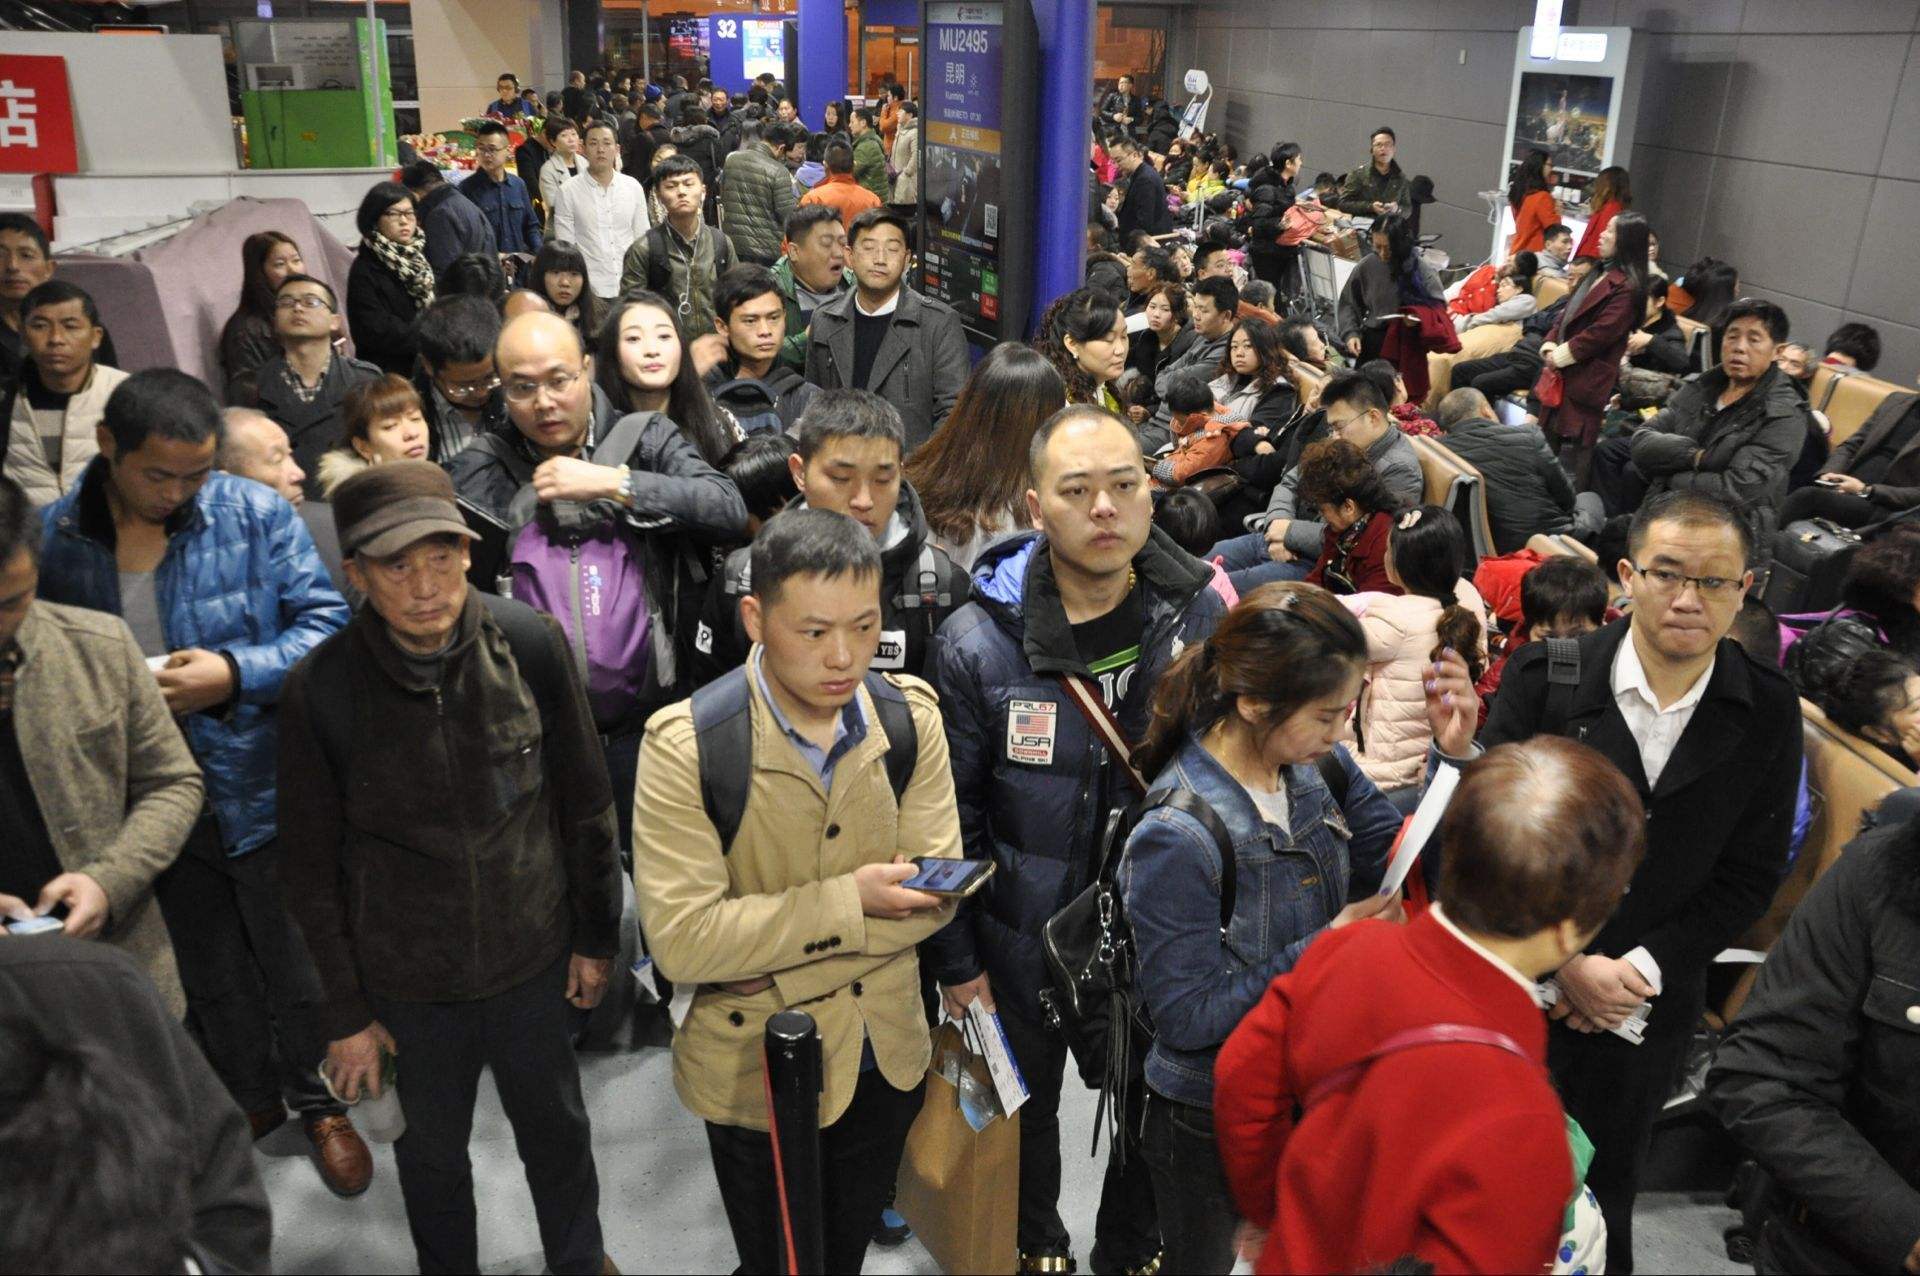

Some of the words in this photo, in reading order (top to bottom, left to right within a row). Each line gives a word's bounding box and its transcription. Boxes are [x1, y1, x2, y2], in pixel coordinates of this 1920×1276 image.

[717, 19, 737, 38] 32
[939, 28, 988, 53] MU2495
[945, 62, 965, 85] 昆明
[880, 645, 900, 657] YES
[1011, 734, 1051, 748] USA
